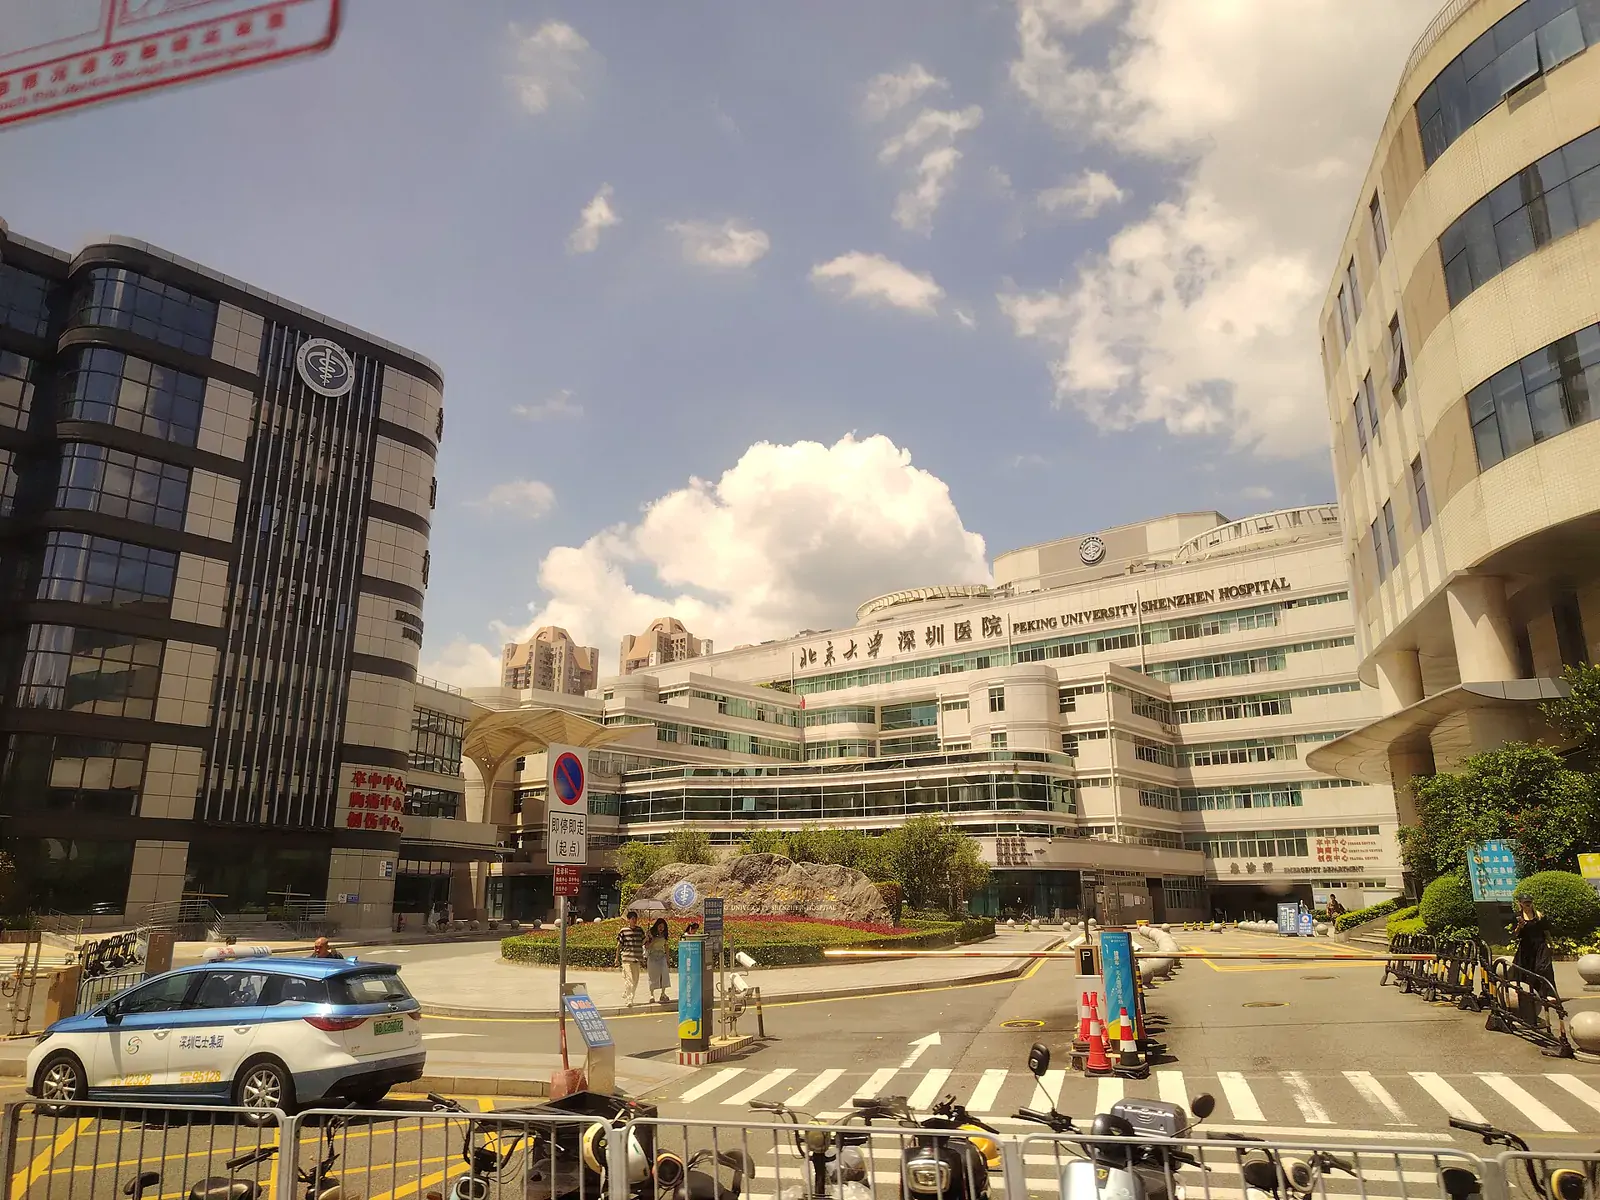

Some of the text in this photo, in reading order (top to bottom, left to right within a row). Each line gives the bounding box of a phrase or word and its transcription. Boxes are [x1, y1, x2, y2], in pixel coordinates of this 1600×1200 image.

[1012, 577, 1291, 635] PEKING UNIVERSITY SHENZHEN HOSPITAL
[551, 817, 584, 836] 即停即走
[555, 839, 580, 858] (起点)
[1081, 951, 1091, 961] P
[179, 1034, 225, 1050] 深圳巴士集团
[123, 1073, 152, 1086] 12328
[192, 1070, 221, 1082] 95128
